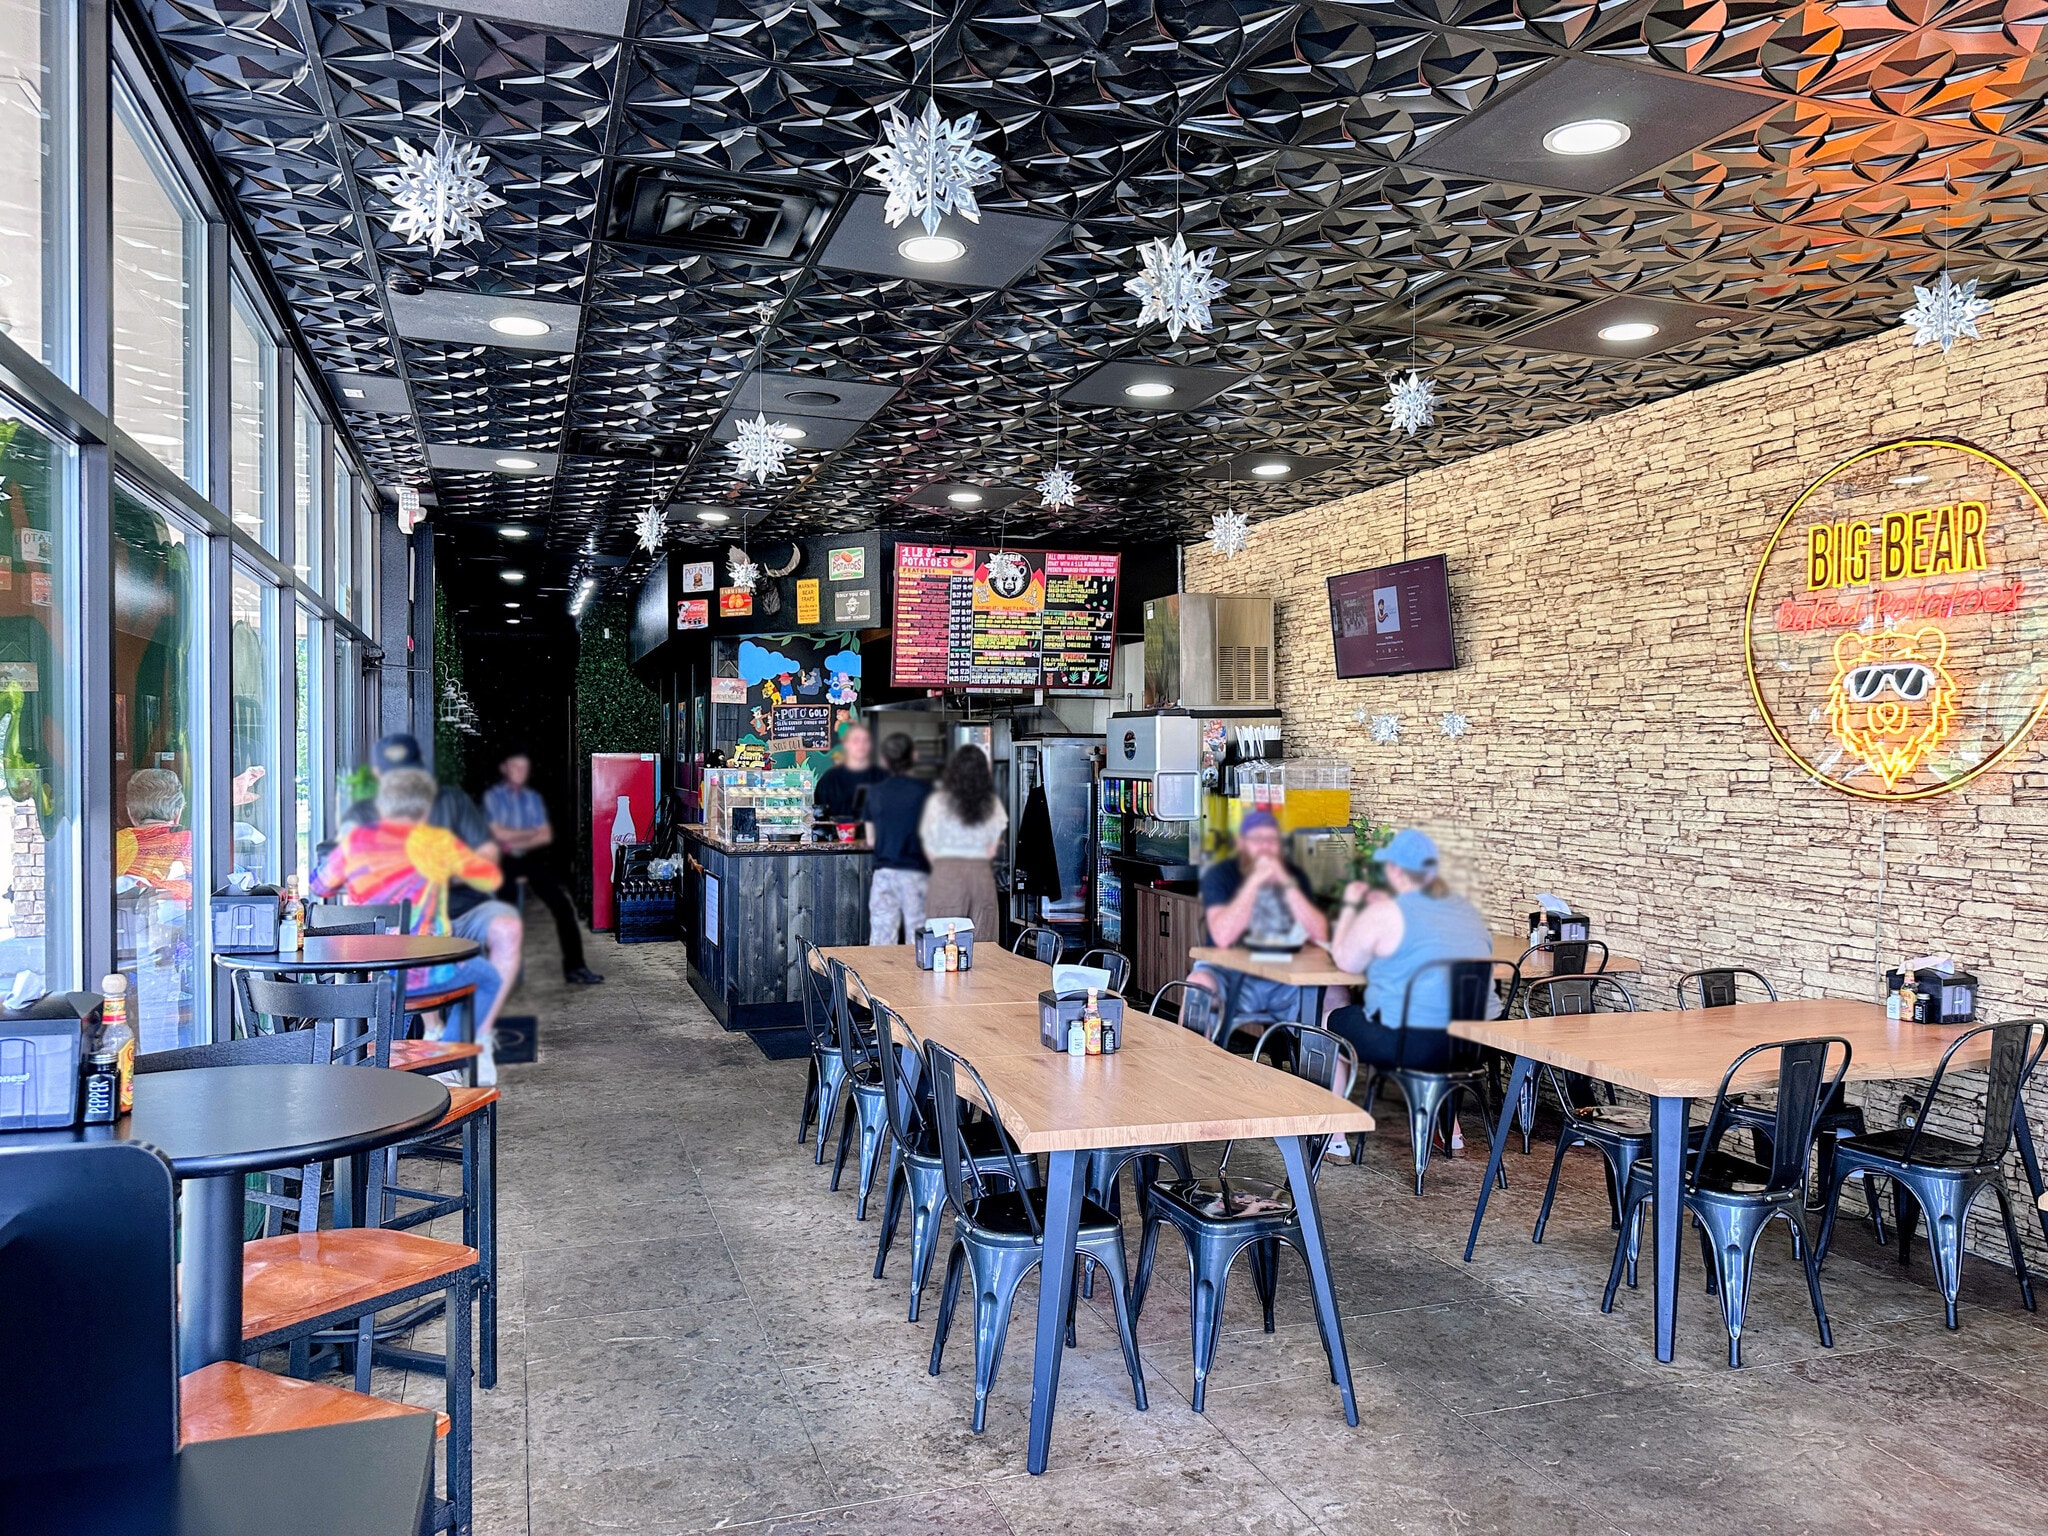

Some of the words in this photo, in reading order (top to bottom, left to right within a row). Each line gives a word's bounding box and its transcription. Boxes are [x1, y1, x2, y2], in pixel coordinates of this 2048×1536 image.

[912, 547, 922, 557] LB
[1807, 521, 1871, 591] BIG
[1881, 501, 1987, 582] BEAR
[833, 558, 862, 572] POTATOES
[902, 557, 948, 567] POTATOES
[684, 566, 712, 577] POTATO
[1776, 593, 1866, 631] Baked
[1873, 580, 2026, 622] Potatoes
[780, 708, 799, 719] POT
[808, 708, 828, 718] GOLD
[88, 1080, 109, 1114] PEPPER
